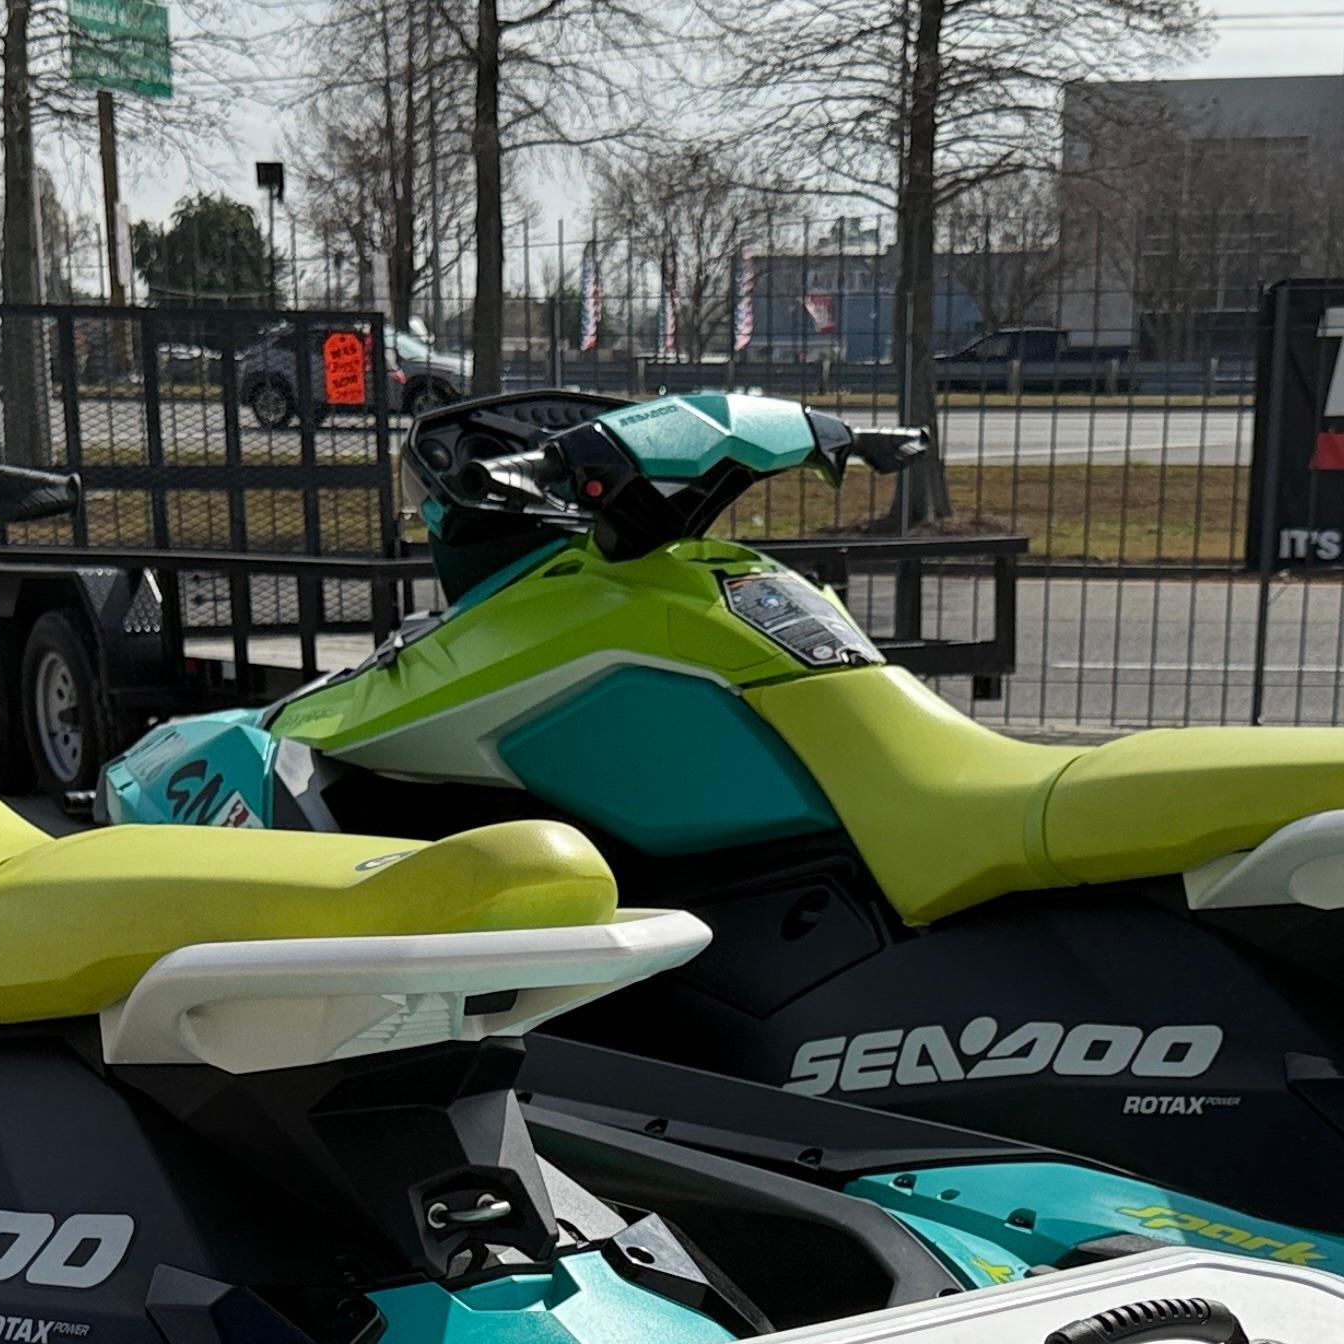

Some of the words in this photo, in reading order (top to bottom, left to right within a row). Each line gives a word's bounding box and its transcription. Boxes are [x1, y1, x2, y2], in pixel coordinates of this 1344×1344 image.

[1279, 530, 1341, 560] IT'S
[1122, 1096, 1206, 1115] ROTAX
[53, 1321, 91, 1336] POWER
